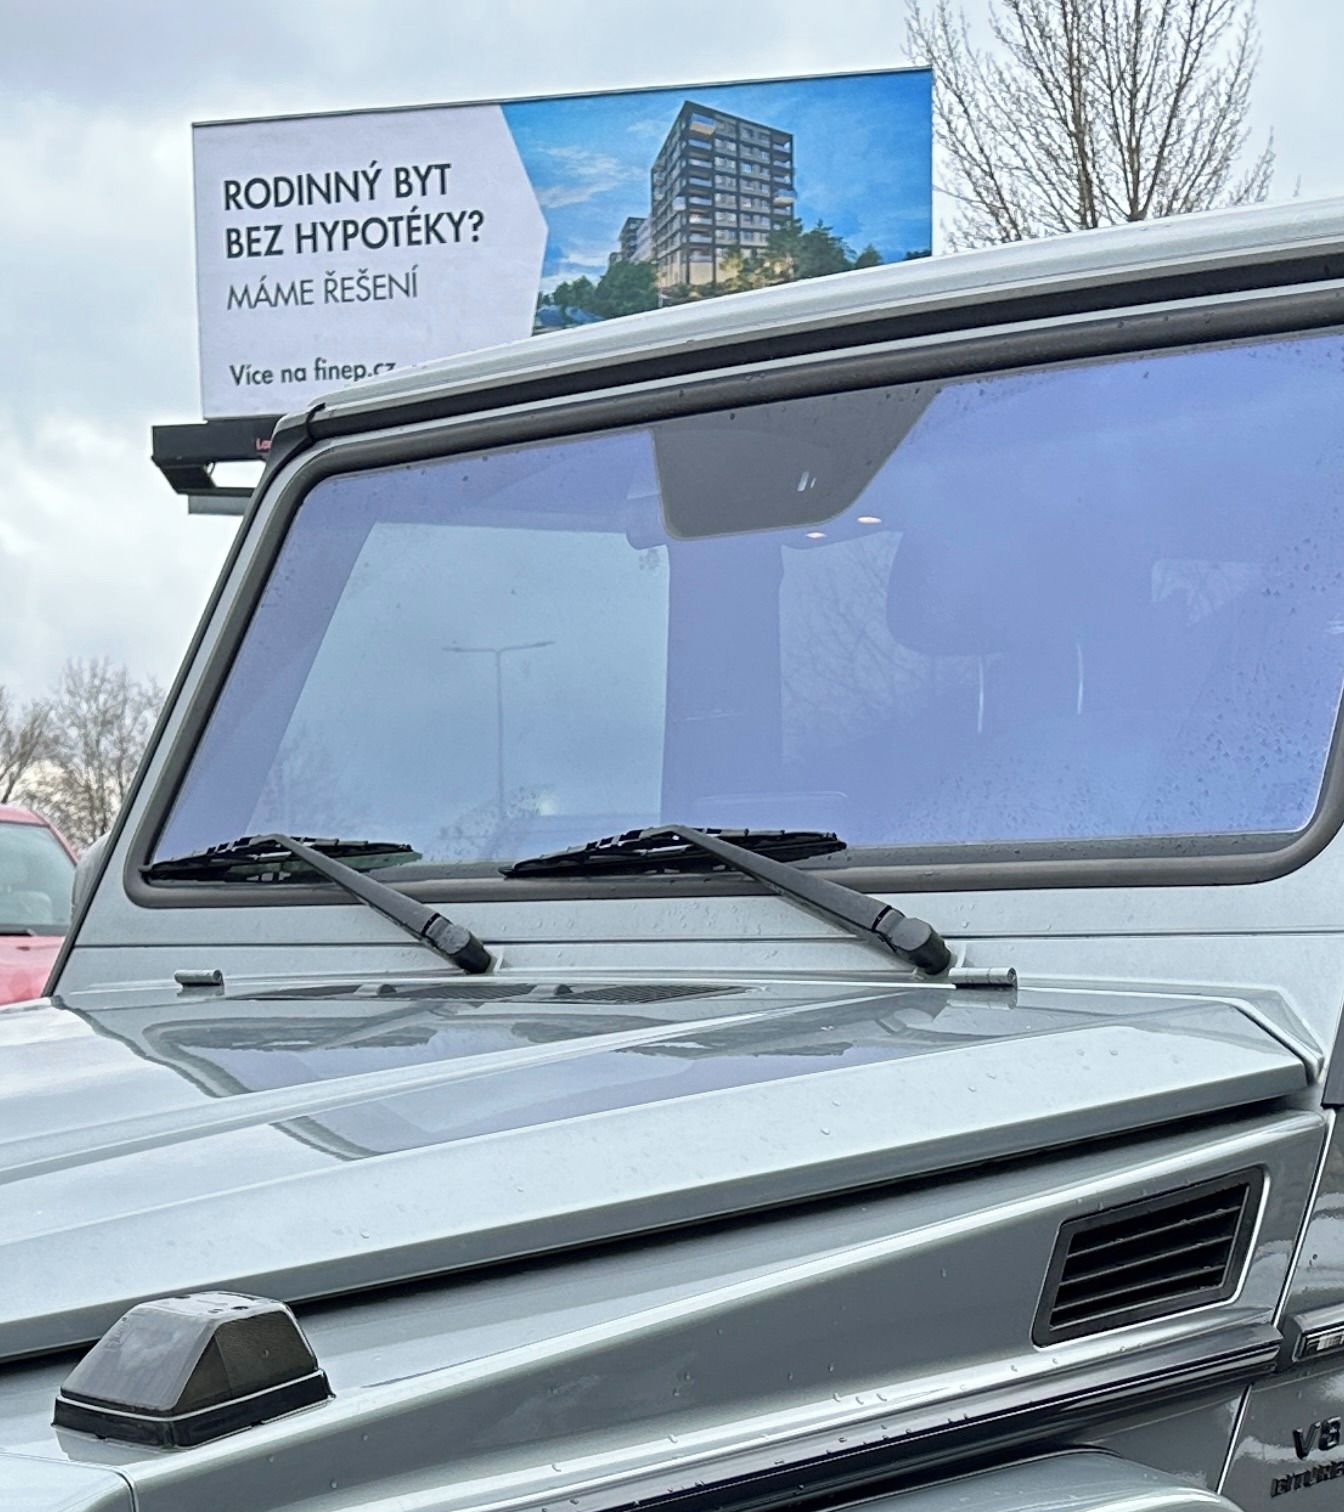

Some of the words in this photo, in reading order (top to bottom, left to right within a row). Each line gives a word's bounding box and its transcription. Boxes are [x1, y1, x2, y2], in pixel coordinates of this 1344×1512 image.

[224, 160, 382, 211] RODINNÝ
[394, 163, 451, 198] BYT
[226, 224, 284, 259] BEZ
[295, 205, 485, 254] HYPOTÉKY?
[227, 275, 315, 310] MÁME
[324, 264, 418, 304] ŘEŠENÍ
[229, 363, 274, 386] Více
[281, 366, 307, 382] na
[1293, 1416, 1342, 1460] V8
